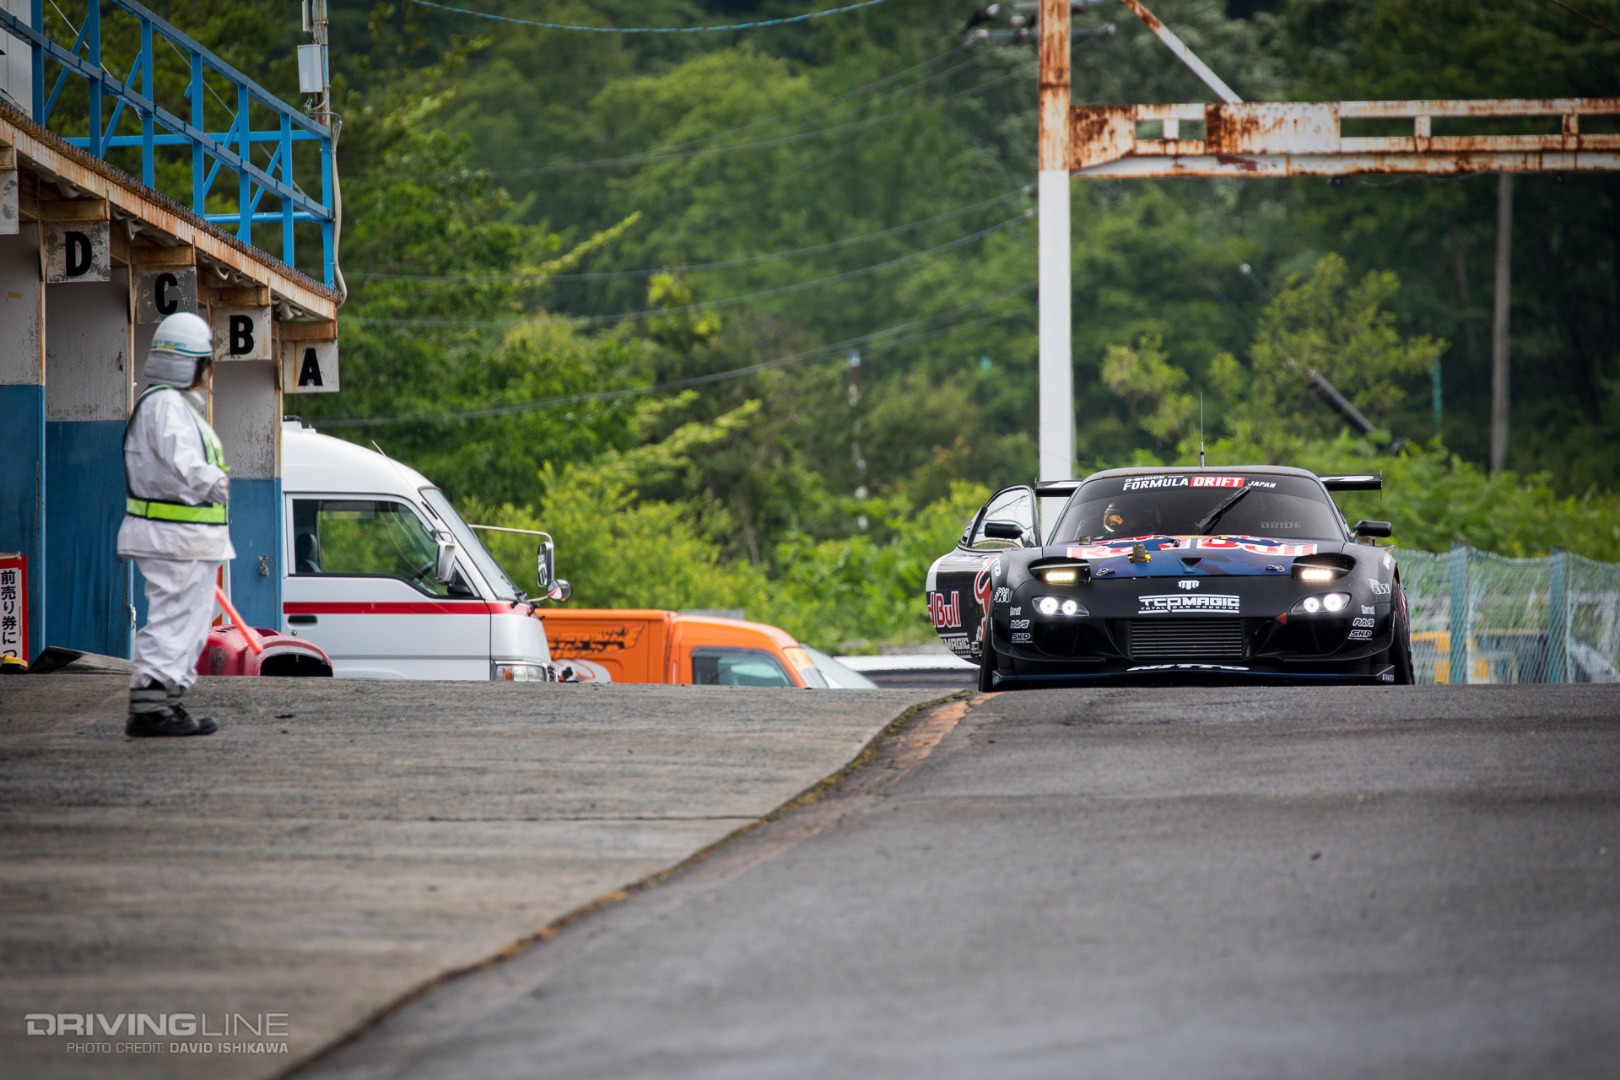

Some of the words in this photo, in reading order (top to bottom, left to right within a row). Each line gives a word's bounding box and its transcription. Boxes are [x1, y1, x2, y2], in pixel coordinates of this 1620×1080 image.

[64, 231, 93, 278] D
[154, 273, 179, 315] C
[229, 314, 255, 356] B
[297, 348, 323, 387] A
[1123, 478, 1189, 491] FORMULA
[1192, 477, 1243, 487] DRIFT
[1248, 480, 1277, 488] JAPAN
[1261, 521, 1302, 529] BRIDE
[935, 590, 962, 628] Bull
[942, 638, 971, 650] MAGIC
